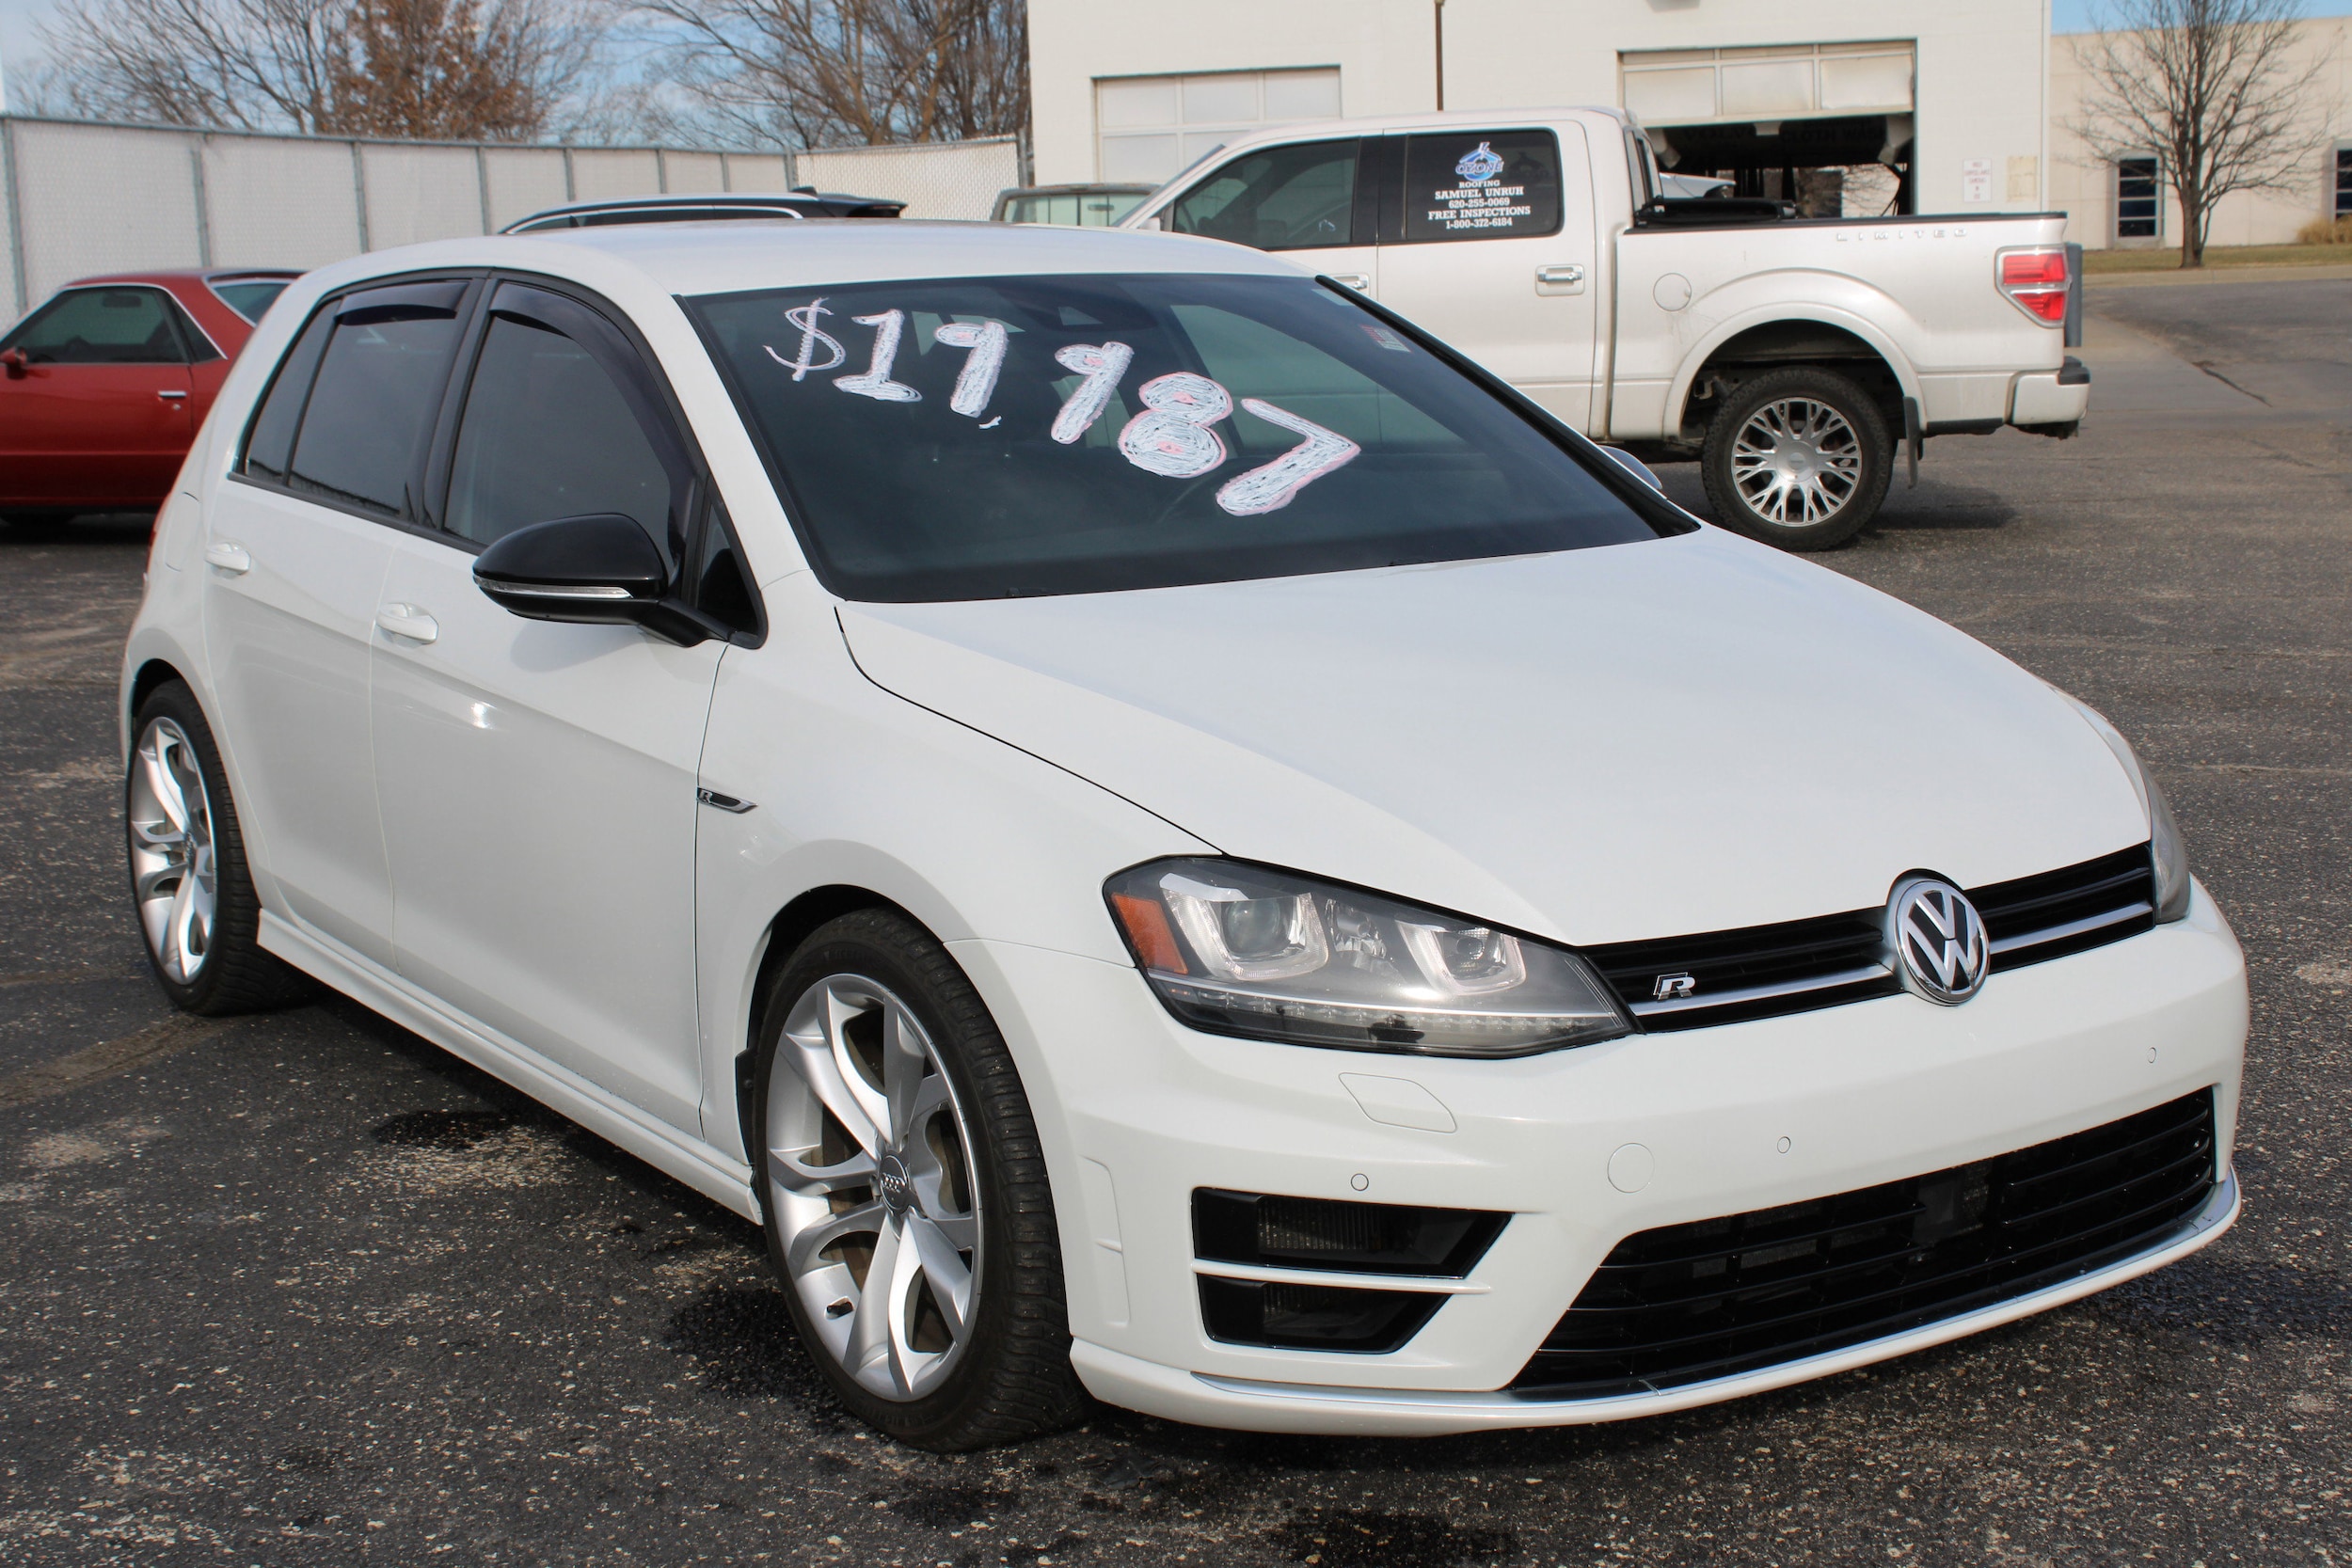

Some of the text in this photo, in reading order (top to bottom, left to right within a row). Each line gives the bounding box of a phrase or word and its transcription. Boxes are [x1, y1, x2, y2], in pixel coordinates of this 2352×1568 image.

[1455, 160, 1505, 175] OZONE
[1459, 180, 1501, 188] ROOFING
[1435, 186, 1524, 200] SAMUEL UNRUH
[1448, 198, 1510, 209] 620-255-0069
[1428, 206, 1531, 220] FREE INSPECTIONS
[1446, 217, 1513, 230] 1-800-372-6184
[1836, 229, 1967, 242] LIMITED
[1653, 972, 1696, 1001] R
